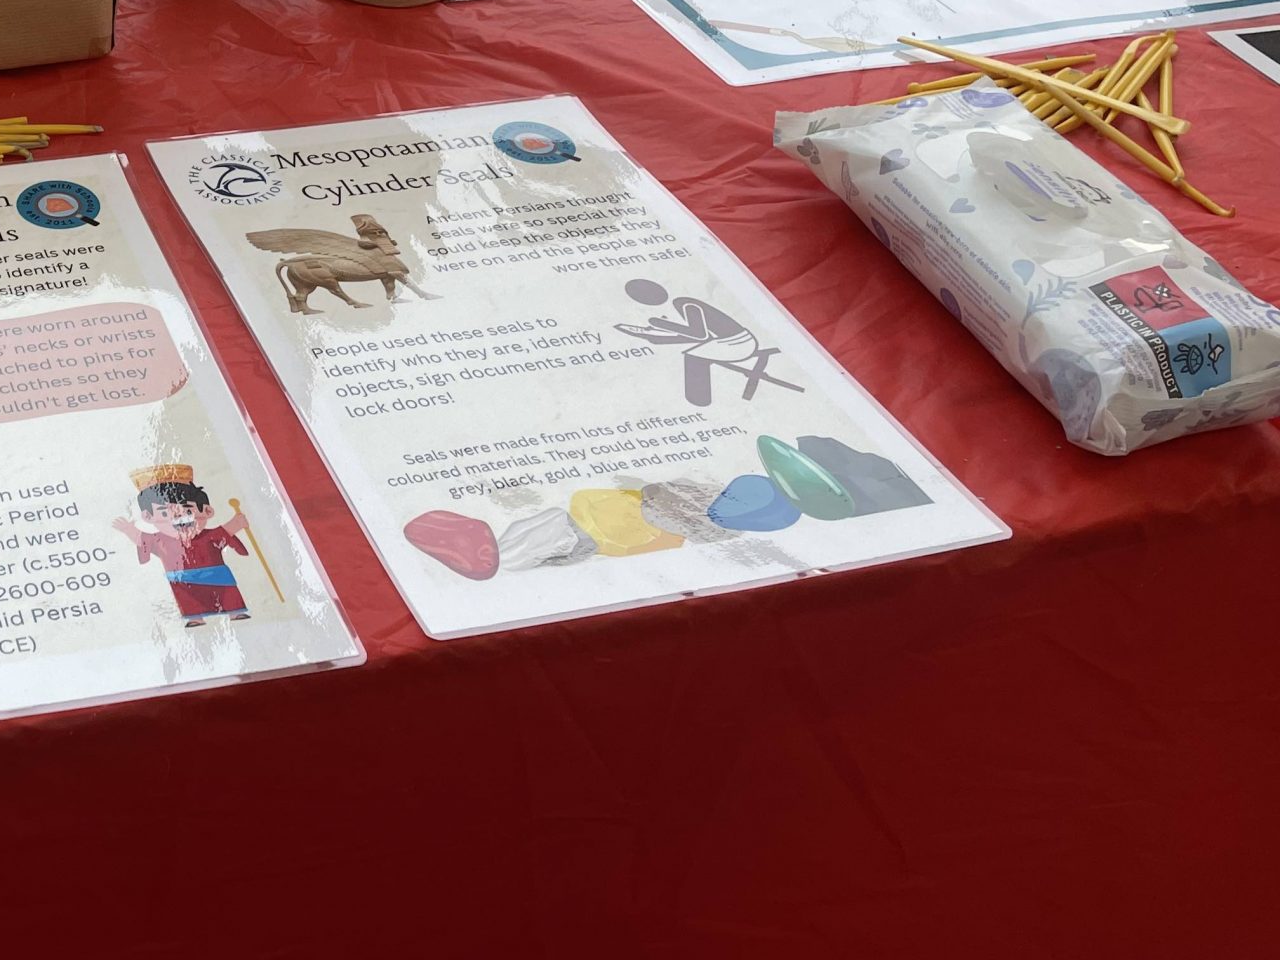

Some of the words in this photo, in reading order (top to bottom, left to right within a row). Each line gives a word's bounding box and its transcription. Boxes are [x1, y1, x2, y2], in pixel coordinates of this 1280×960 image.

[270, 134, 490, 169] Mesopotamian
[189, 165, 202, 184] THE
[202, 153, 275, 175] CLASSICAL
[195, 179, 282, 206] ASSOCIATION
[302, 173, 434, 206] Cylinder
[438, 162, 514, 185] Seals
[46, 218, 74, 226] 2011
[14, 249, 58, 262] seals
[62, 243, 105, 257] were
[6, 263, 73, 279] identify
[79, 262, 90, 270] a
[0, 276, 88, 296] signature!
[311, 339, 379, 360] People
[382, 334, 428, 349] used
[430, 327, 484, 343] these
[486, 320, 535, 335] seals
[536, 317, 557, 330] to
[1100, 292, 1144, 328] PLASTIC
[1139, 326, 1154, 337] IN
[1149, 337, 1179, 393] PRODUCT
[323, 351, 396, 379] identify
[401, 351, 442, 367] who
[445, 345, 488, 365] they
[493, 341, 530, 356] are,
[532, 330, 602, 350] identify
[335, 375, 414, 400] objects,
[416, 370, 456, 388] sign
[460, 355, 566, 381] documents
[569, 350, 606, 366] and
[609, 344, 655, 359] even
[345, 400, 389, 419] lock
[392, 392, 455, 412] doors!
[18, 480, 70, 499] used
[9, 502, 79, 524] Period
[25, 528, 80, 546] were
[22, 548, 117, 574] (c.5500-
[31, 600, 103, 624] Persia
